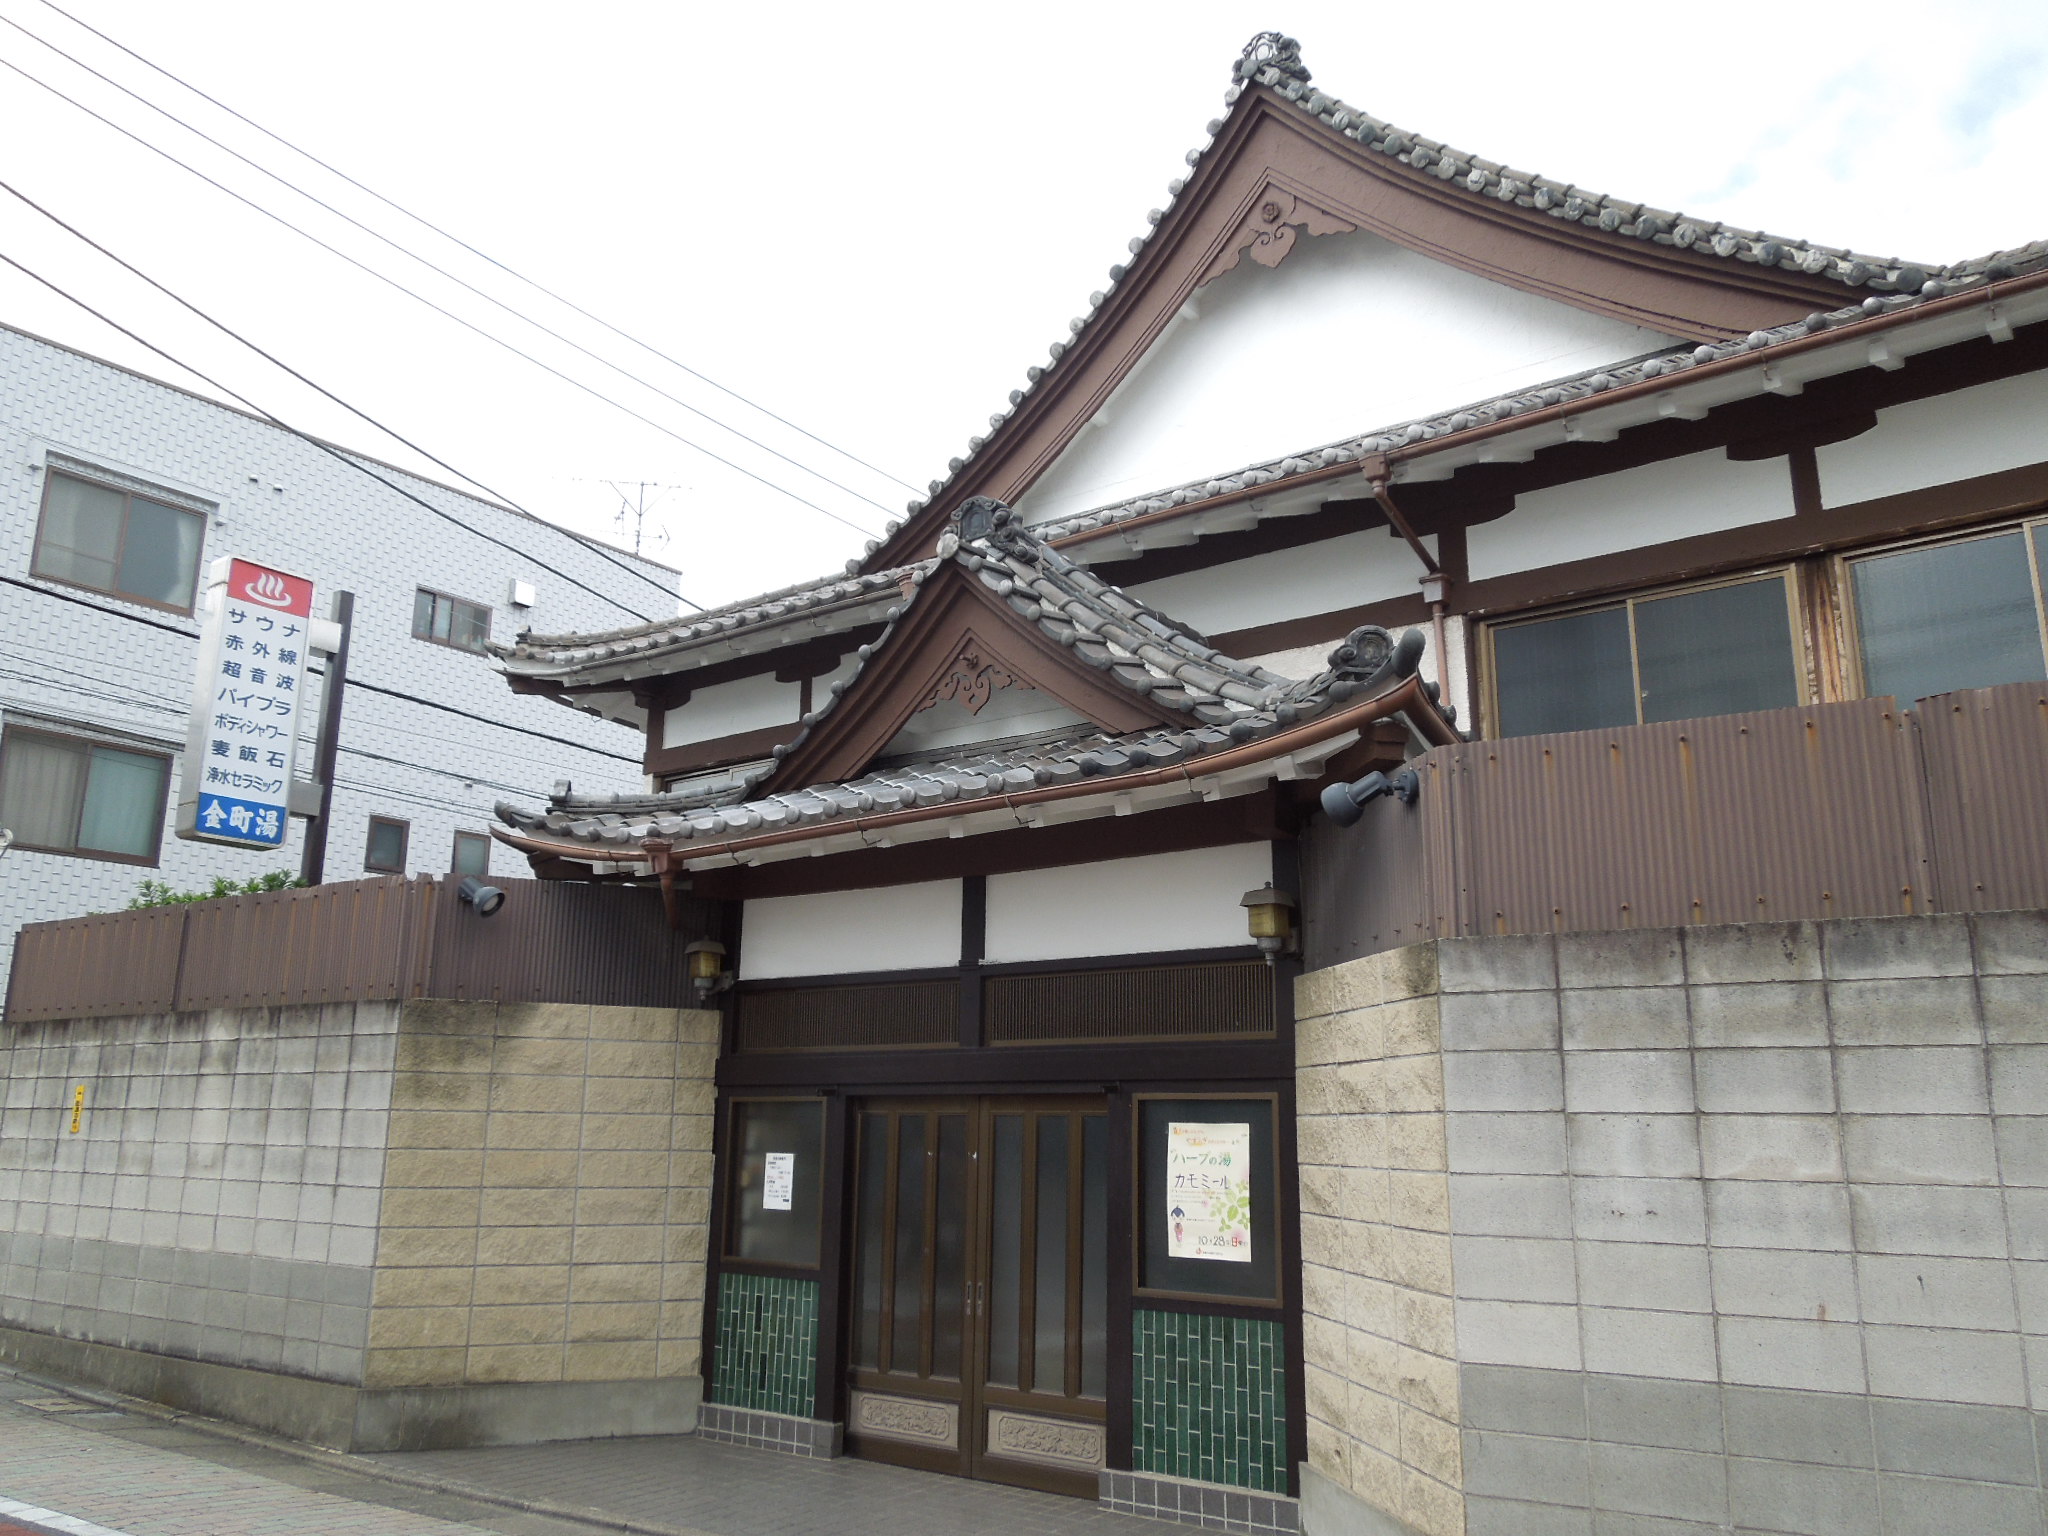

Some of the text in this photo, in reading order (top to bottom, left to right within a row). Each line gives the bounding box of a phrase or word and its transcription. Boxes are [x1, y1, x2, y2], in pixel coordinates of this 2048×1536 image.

[228, 607, 301, 637] サウナ
[225, 634, 298, 665] 赤外線
[221, 660, 296, 692] 超音波
[214, 713, 288, 739] ボディシャワー
[211, 739, 286, 768] 麦飯石
[206, 766, 283, 794] 浄水セラミック
[201, 799, 279, 839] 金町湯
[1174, 1173, 1230, 1190] カモミール
